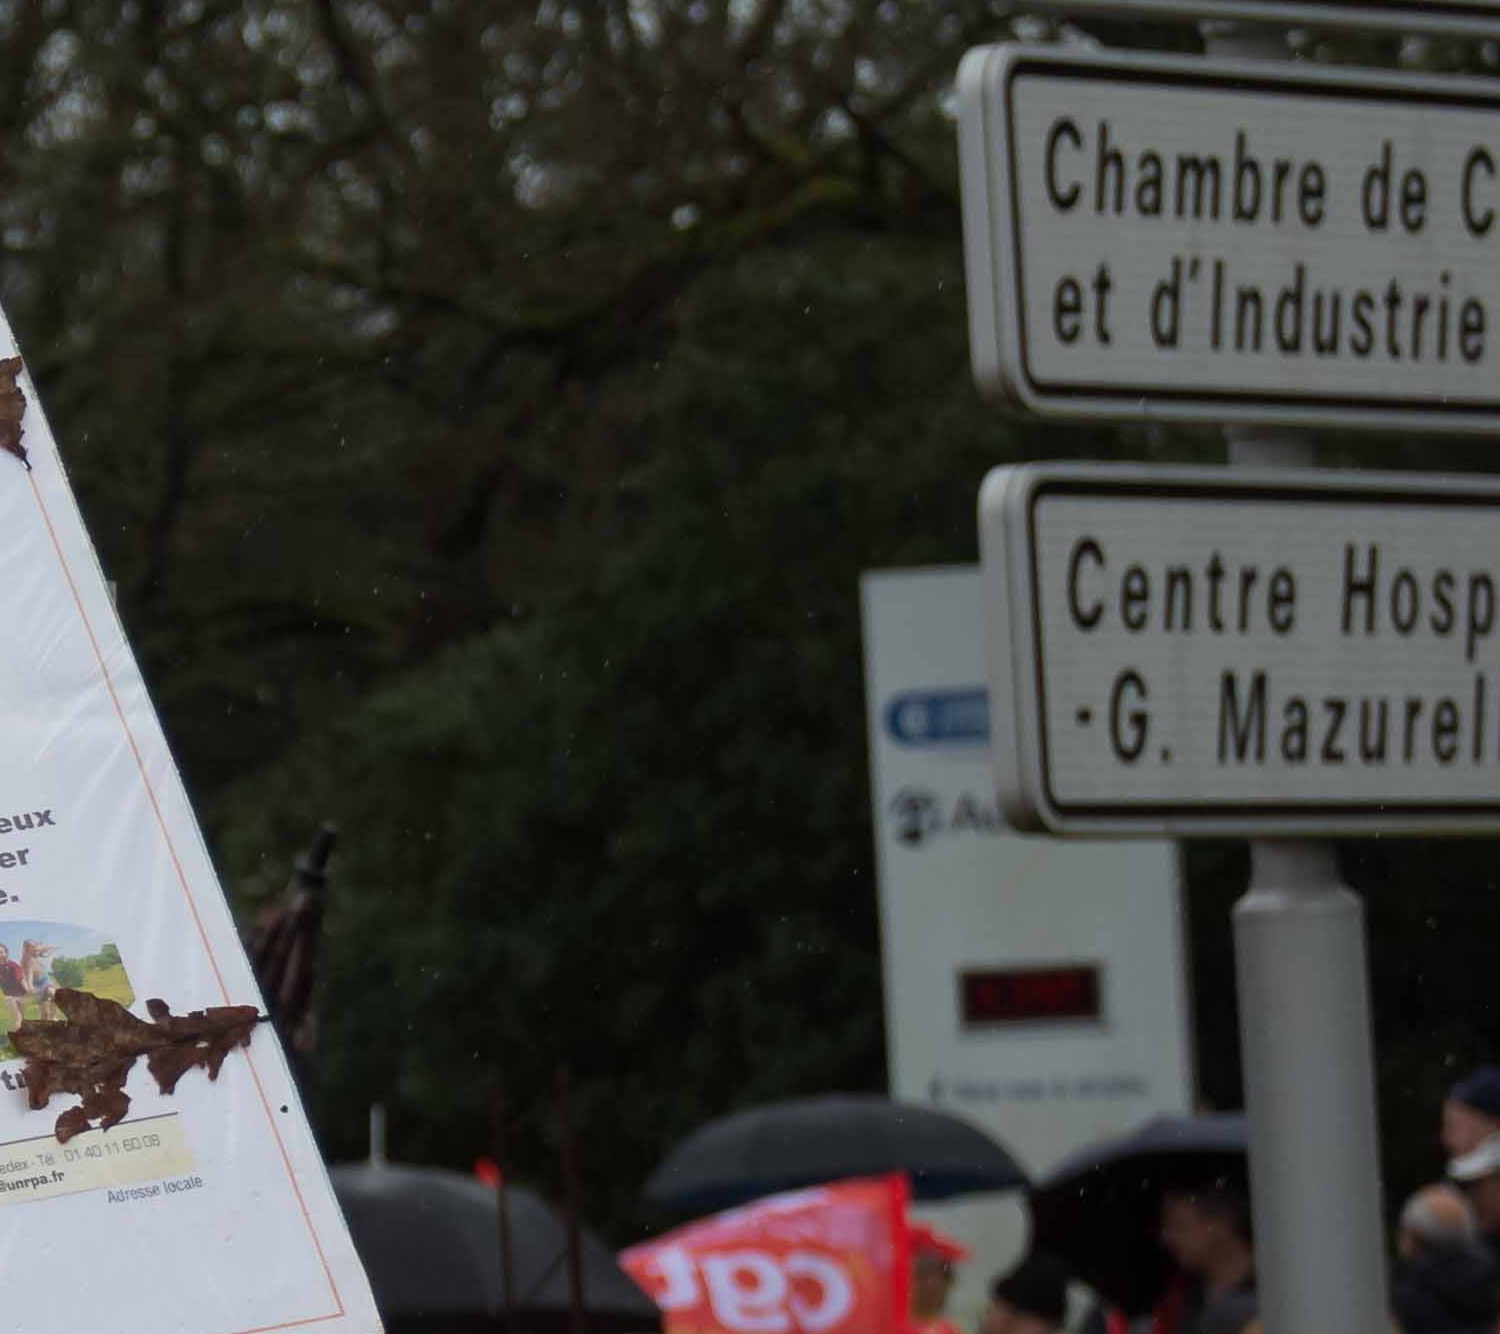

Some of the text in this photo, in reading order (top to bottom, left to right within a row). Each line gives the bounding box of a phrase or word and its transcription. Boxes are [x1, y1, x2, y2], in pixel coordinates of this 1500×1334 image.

[1043, 117, 1327, 228] Chambre
[1362, 139, 1427, 237] de
[1052, 258, 1488, 364] et d'Industrie
[1067, 537, 1297, 634] Centre
[63, 1147, 81, 1162] 01
[83, 1143, 102, 1159] 40
[103, 1140, 119, 1155] 11
[141, 1132, 161, 1148] 08
[106, 1175, 203, 1204] Adresse locale
